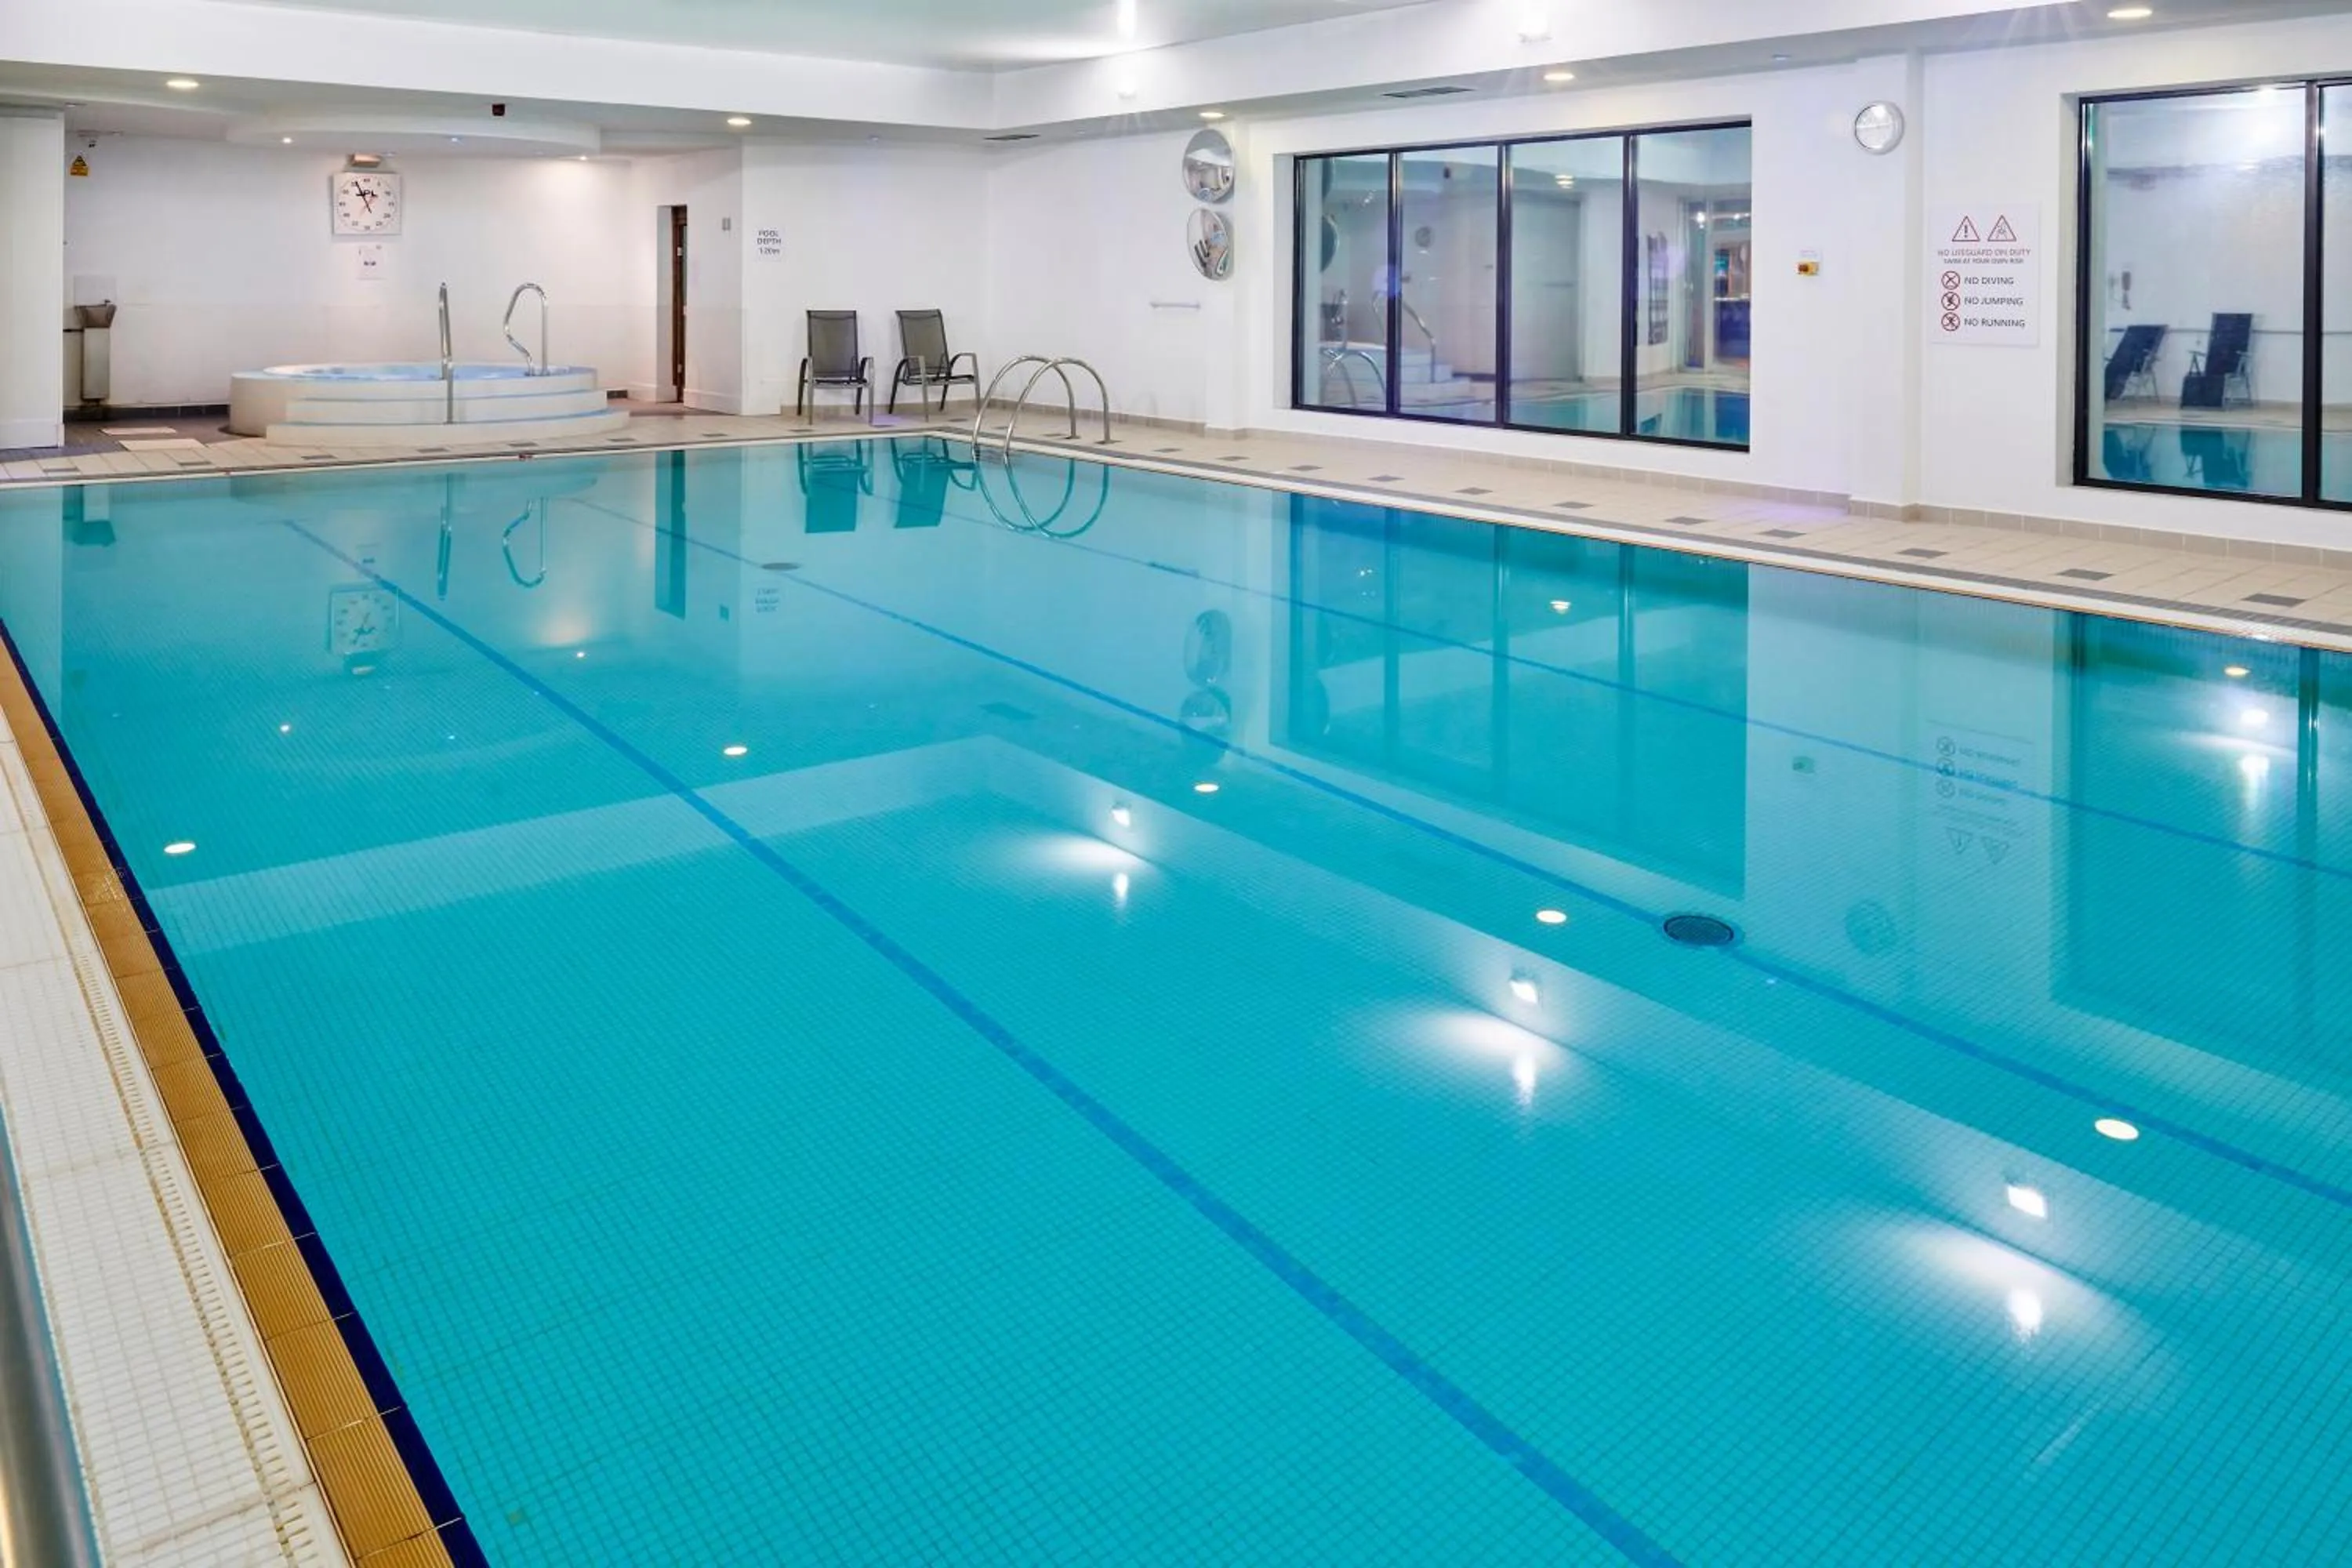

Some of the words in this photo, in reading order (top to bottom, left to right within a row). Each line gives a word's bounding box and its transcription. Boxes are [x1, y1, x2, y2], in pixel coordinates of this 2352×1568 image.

[2009, 248, 2031, 256] DUTY
[1981, 277, 2014, 285] DIVING
[1980, 297, 2024, 306] JUMPING
[1964, 318, 1979, 326] NO
[1981, 318, 2025, 328] RUNNING
